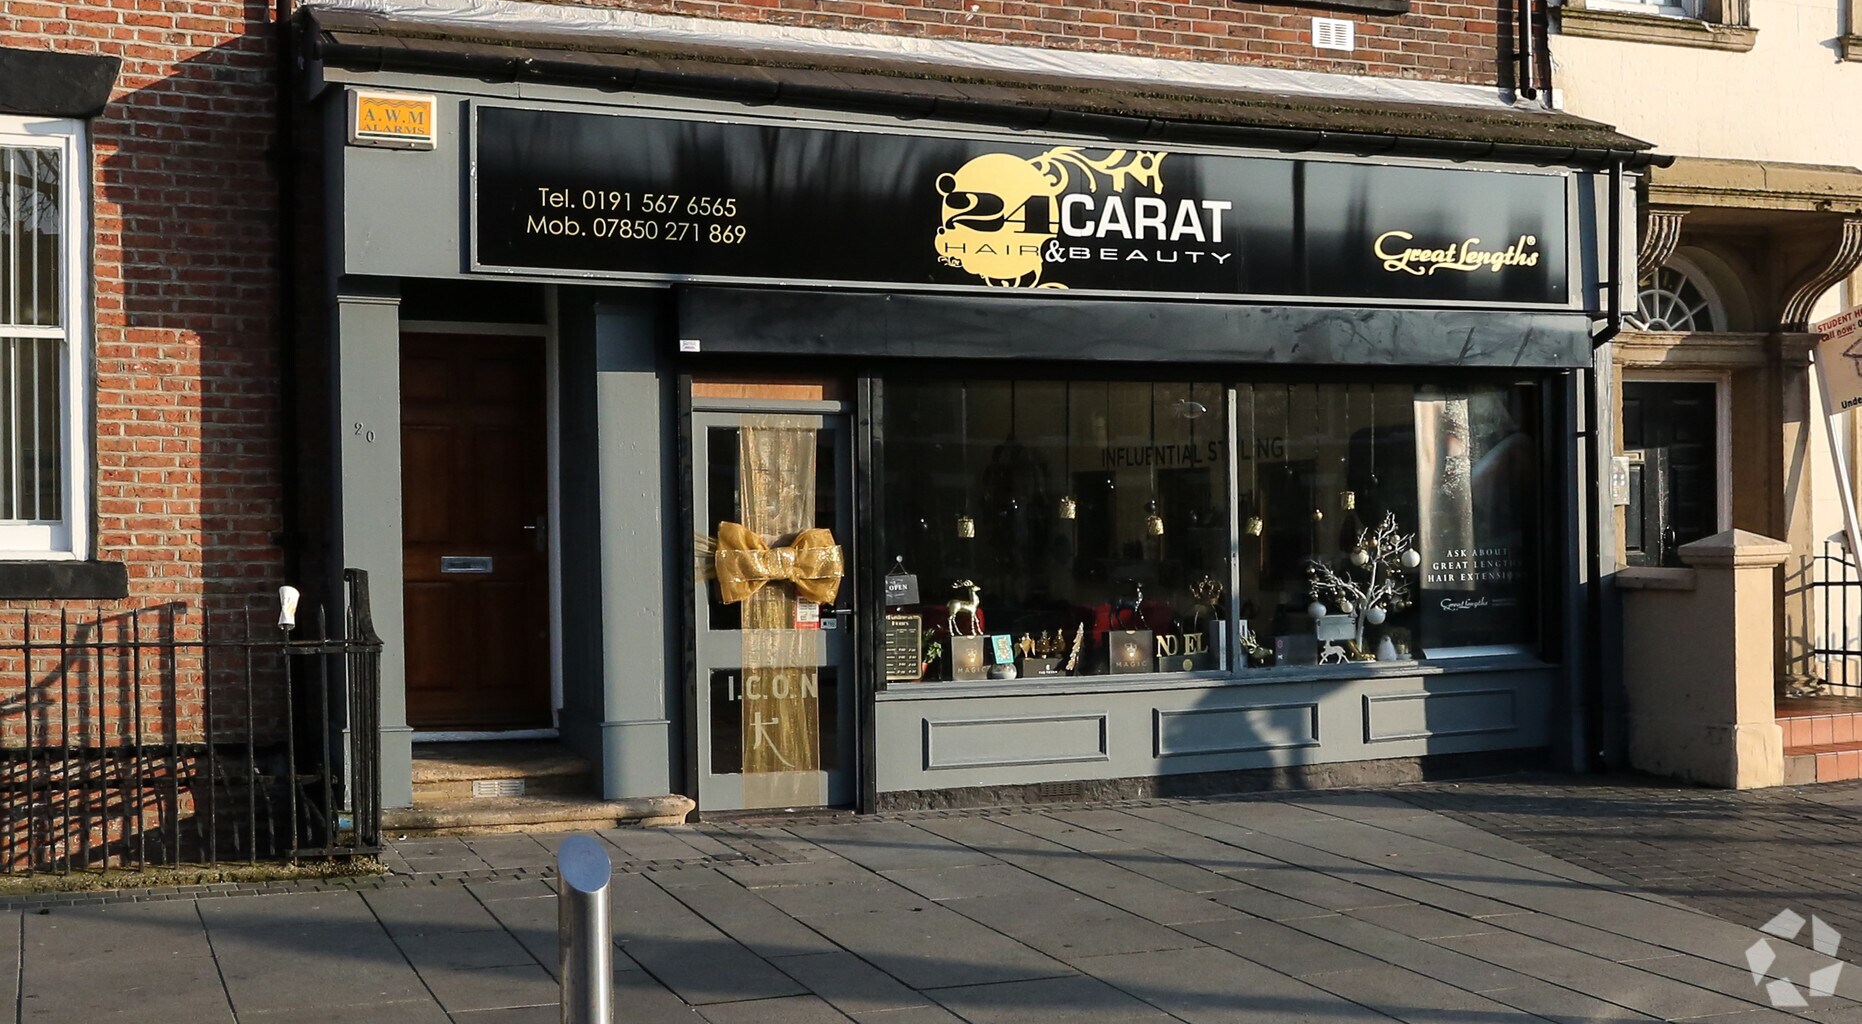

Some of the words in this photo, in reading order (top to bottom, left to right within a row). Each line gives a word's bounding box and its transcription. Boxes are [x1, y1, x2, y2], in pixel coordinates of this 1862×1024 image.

[364, 108, 424, 125] A.W.M
[363, 124, 425, 135] ALARMS
[538, 187, 575, 209] Tel.
[582, 189, 631, 212] 0191
[641, 193, 680, 214] 567
[687, 196, 737, 218] 6565
[944, 191, 1060, 234] 24
[1061, 193, 1232, 243] CARAT
[526, 215, 586, 237] Mob.
[593, 218, 659, 240] 07850
[665, 221, 699, 242] 271
[709, 223, 747, 244] 869
[944, 242, 1041, 257] HAIR
[1045, 239, 1067, 263] &
[1069, 247, 1233, 265] BEAUTY
[1374, 230, 1457, 276] Great
[1446, 234, 1539, 275] Lengths
[1817, 312, 1852, 333] STUDENT
[354, 422, 375, 444] 20
[1102, 444, 1202, 467] INFLUENTIAL
[1207, 437, 1284, 461] STLNG
[1446, 549, 1467, 558] ASK
[1472, 548, 1507, 557] ABOUT
[1432, 561, 1468, 571] GREAT
[1473, 559, 1516, 569] LENGTH
[1427, 574, 1455, 583] HAIR
[1460, 571, 1519, 582] EXTENSIO
[957, 665, 986, 674] MAGIC
